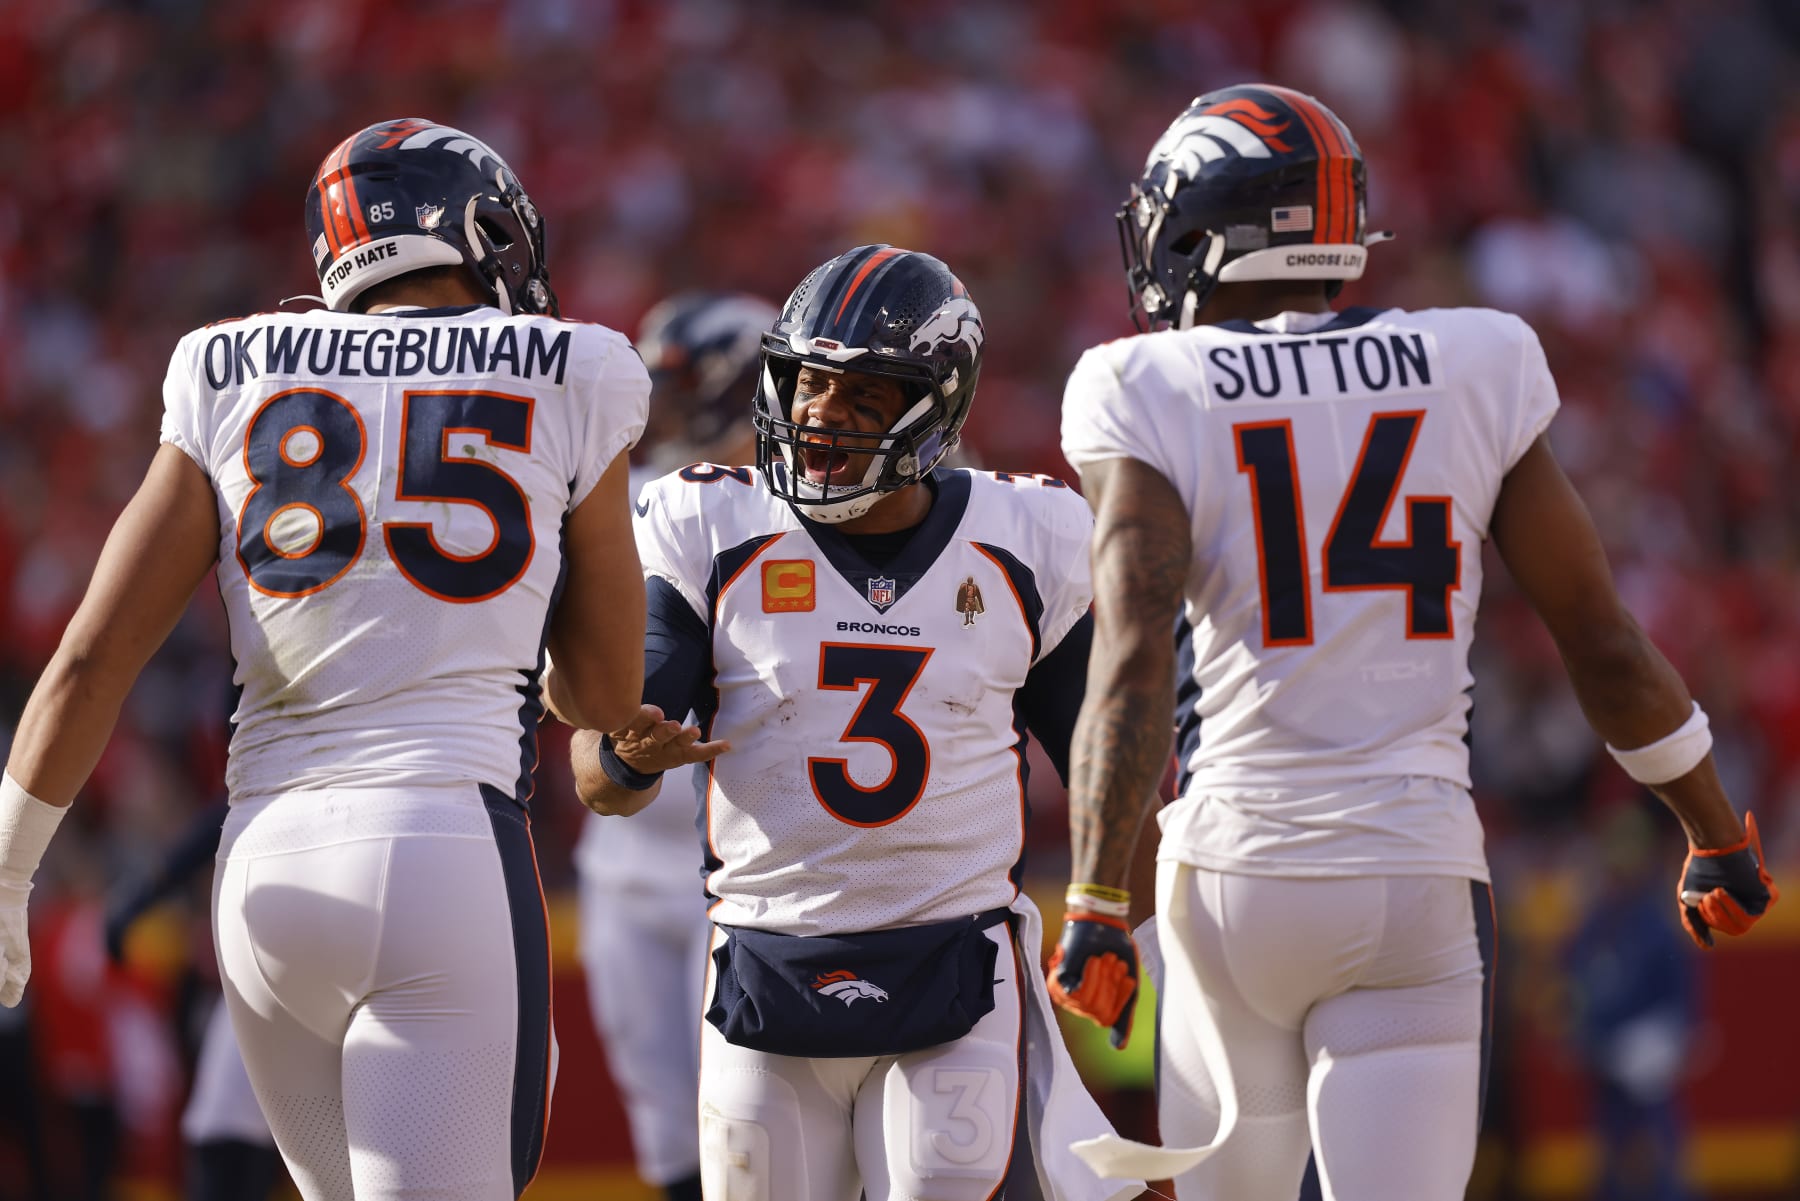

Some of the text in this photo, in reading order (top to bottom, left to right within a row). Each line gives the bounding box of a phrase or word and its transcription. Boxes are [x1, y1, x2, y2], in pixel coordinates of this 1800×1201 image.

[369, 202, 395, 223] 85
[327, 242, 398, 290] STOP HATE
[1286, 254, 1342, 267] CHOOSE
[204, 325, 571, 390] OKWUEGBUNAM
[1209, 334, 1431, 400] SUTTON
[236, 387, 536, 604] 85
[1232, 409, 1462, 649] 14
[766, 563, 811, 598] C
[873, 590, 891, 602] NFL
[837, 621, 921, 636] BRONCOS
[808, 641, 936, 828] 3
[930, 1068, 993, 1165] 3
